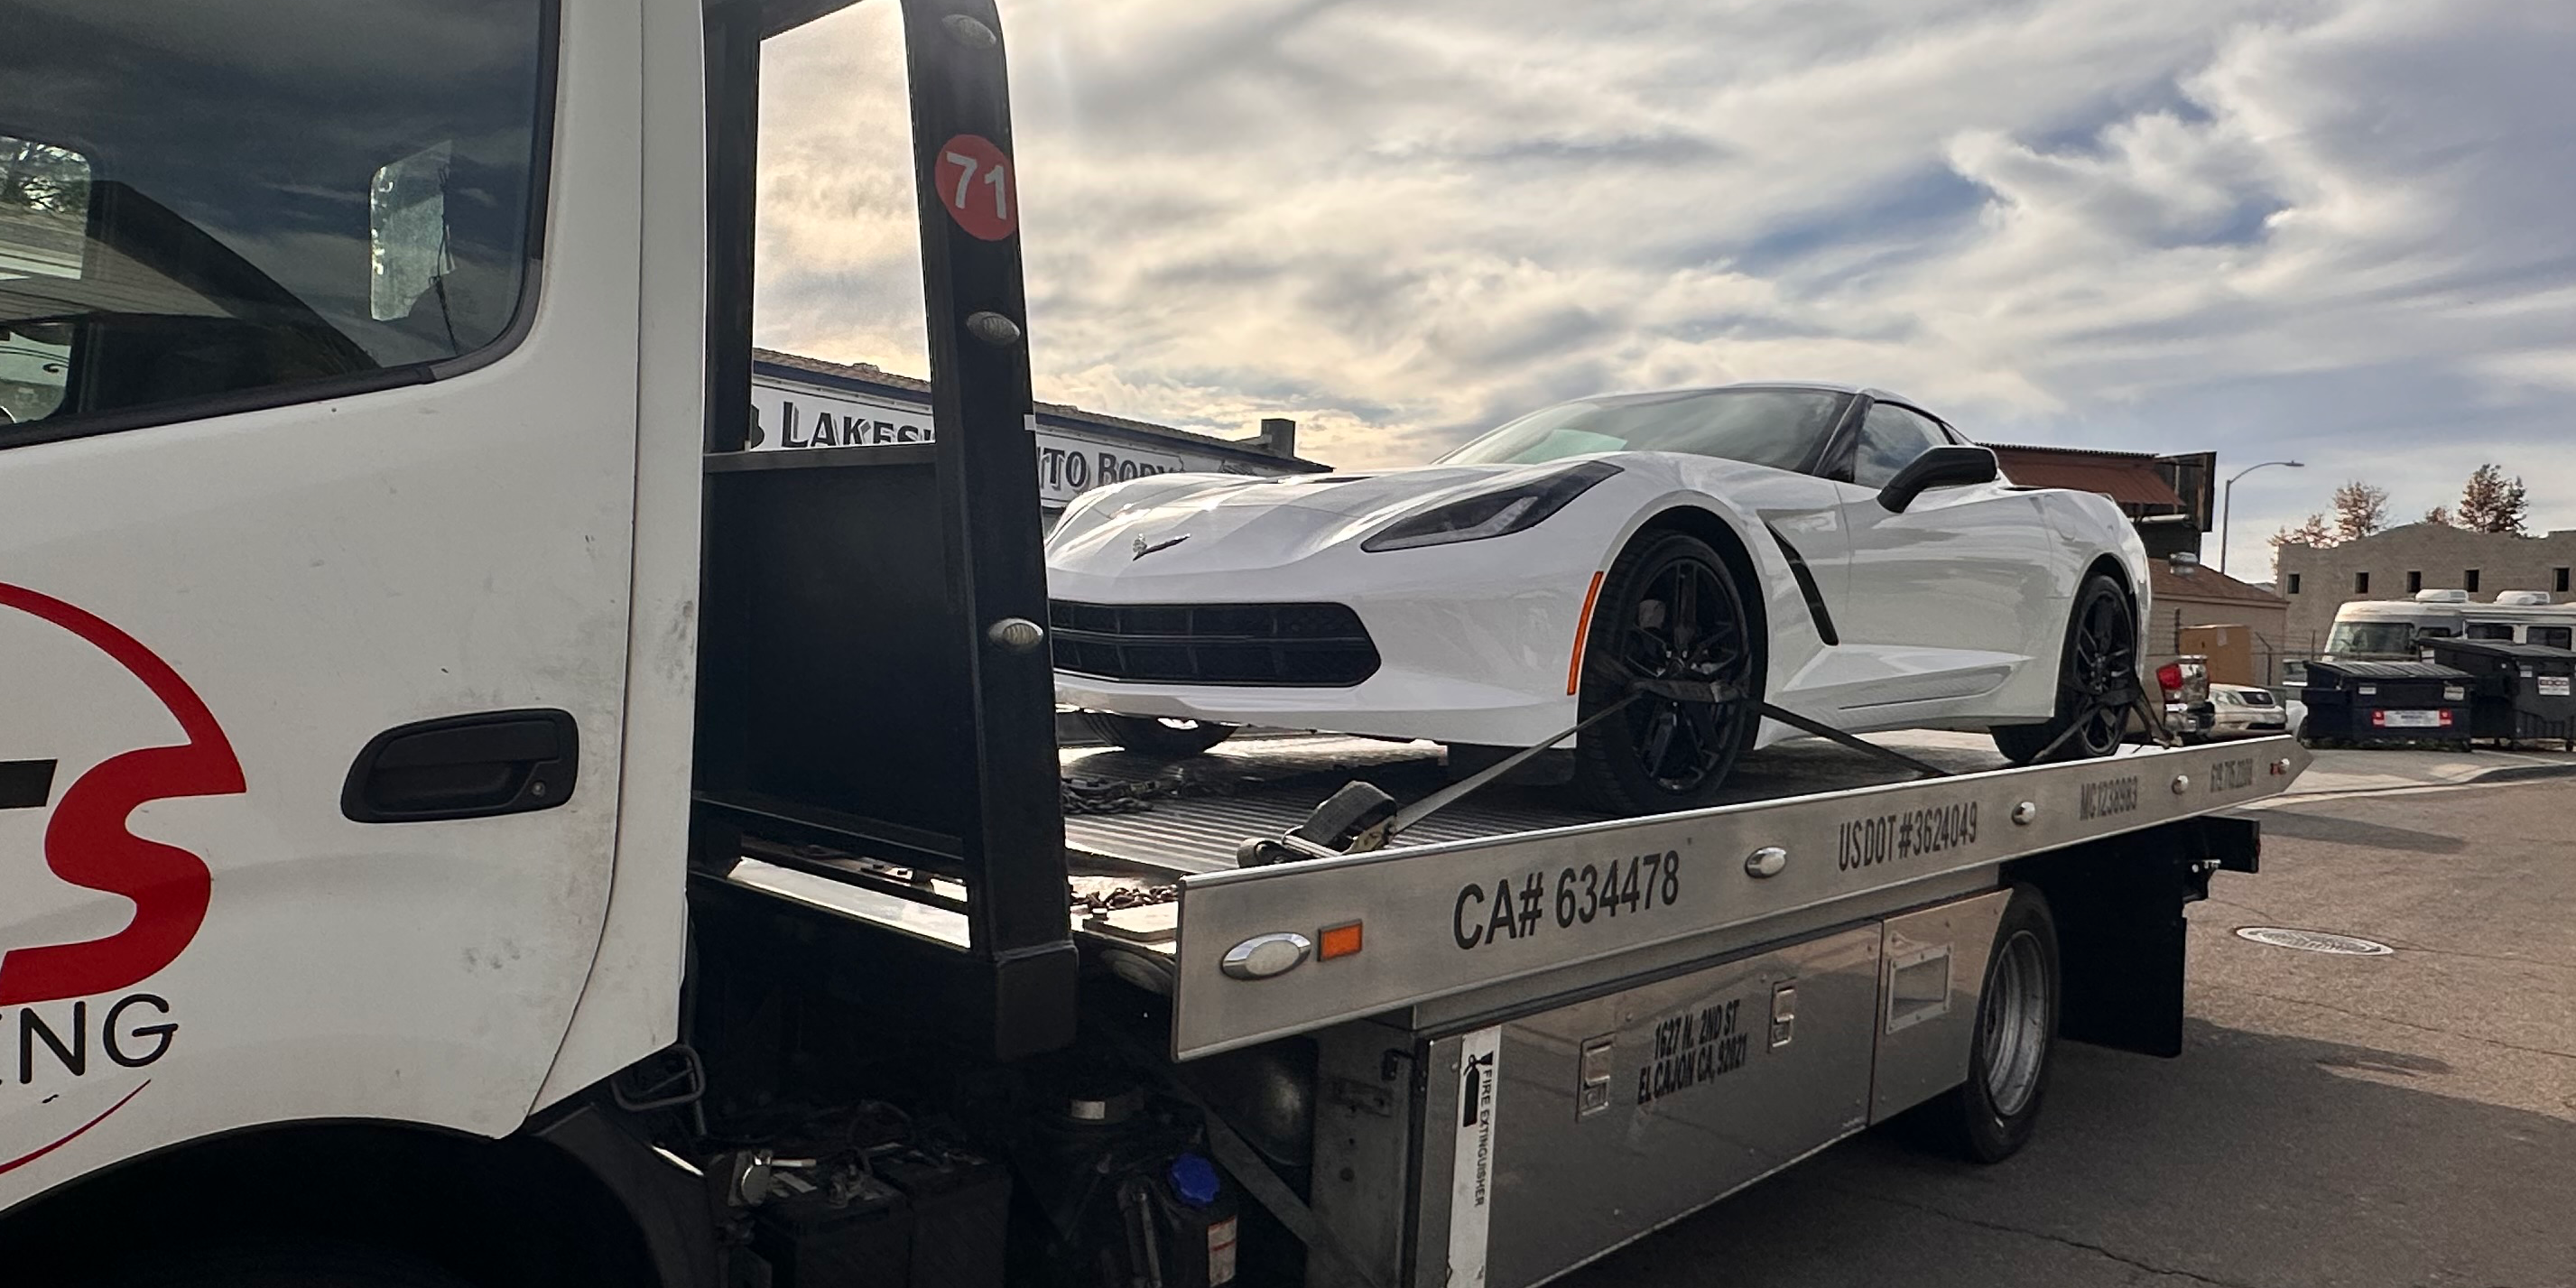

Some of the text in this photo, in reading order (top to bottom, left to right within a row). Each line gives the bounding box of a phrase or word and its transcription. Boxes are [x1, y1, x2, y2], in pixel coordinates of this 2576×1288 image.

[945, 150, 1007, 220] 71
[781, 401, 933, 448] LAKES
[1453, 850, 1680, 950] CA# 634478
[0, 993, 179, 1085] NG
[1654, 1016, 1682, 1061] 1627
[1699, 1004, 1722, 1045] 2ND
[1724, 998, 1740, 1036] ST
[1637, 1065, 1652, 1106] EL
[1654, 1050, 1697, 1099] CAJON
[1474, 1068, 1493, 1208] FIRE EXTINGUISHER
